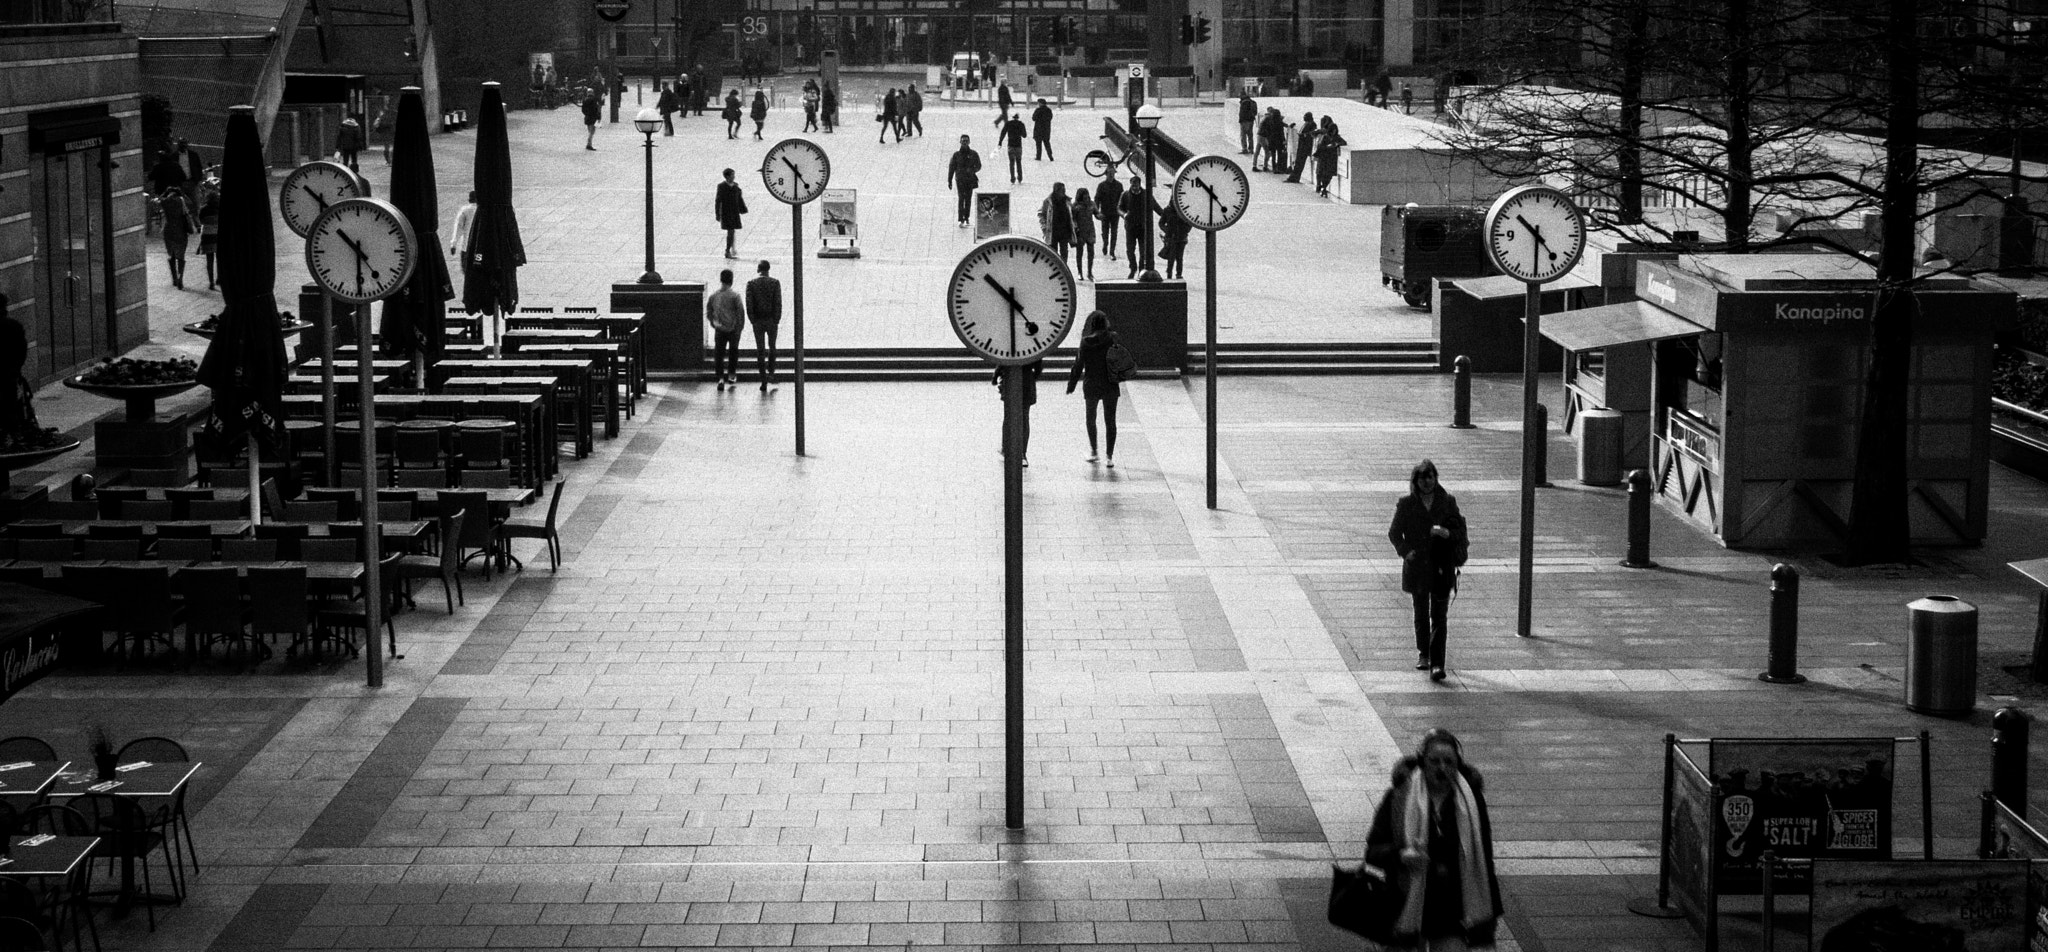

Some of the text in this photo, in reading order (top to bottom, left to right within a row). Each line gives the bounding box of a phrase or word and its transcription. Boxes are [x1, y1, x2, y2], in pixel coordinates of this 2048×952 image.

[742, 15, 768, 35] 35
[778, 177, 784, 186] 8
[337, 186, 345, 197] 2
[1507, 230, 1515, 242] 9
[1775, 302, 1865, 325] Kanapina
[1728, 802, 1750, 816] 350
[1842, 812, 1874, 824] SPICES
[1770, 827, 1811, 846] SALT
[1842, 834, 1874, 847] GLOBE
